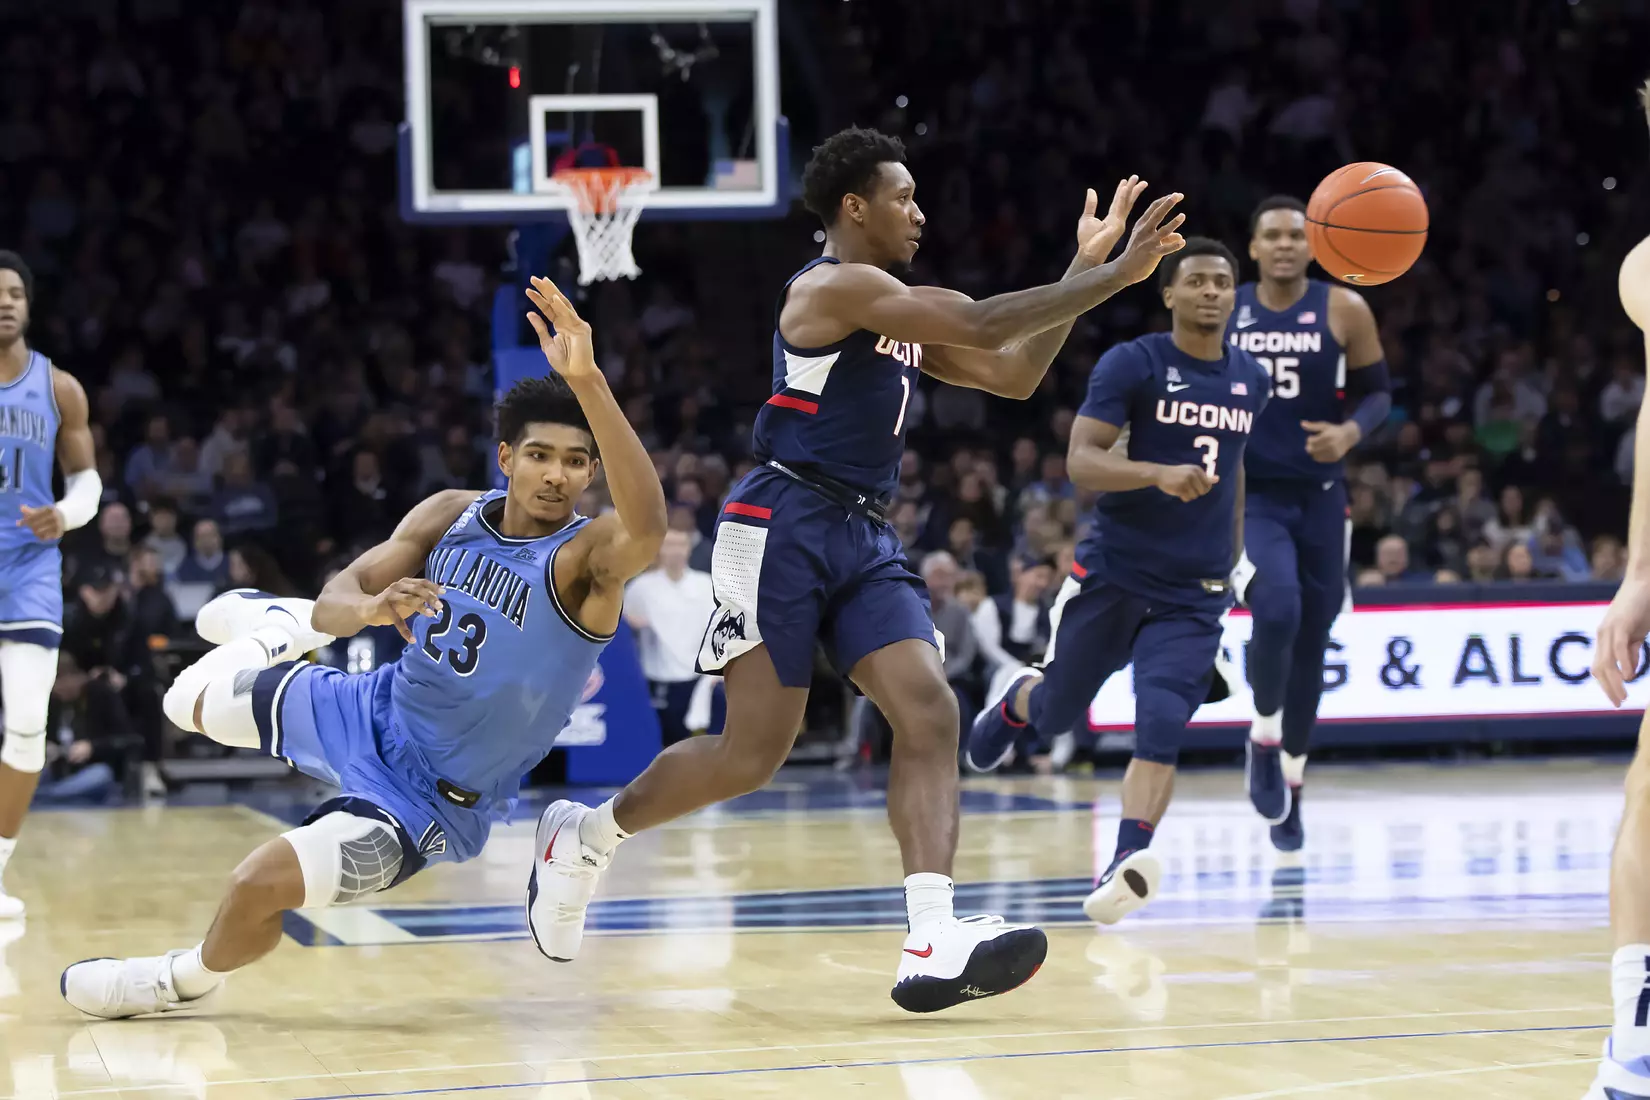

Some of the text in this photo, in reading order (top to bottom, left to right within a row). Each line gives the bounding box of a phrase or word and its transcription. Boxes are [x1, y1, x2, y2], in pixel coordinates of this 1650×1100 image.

[1230, 331, 1321, 353] UCONN
[893, 375, 910, 436] 1
[1156, 399, 1253, 434] UCONN
[1193, 435, 1219, 479] 3
[422, 599, 488, 677] 23
[1380, 636, 1423, 690] &
[1452, 631, 1650, 685] ALC
